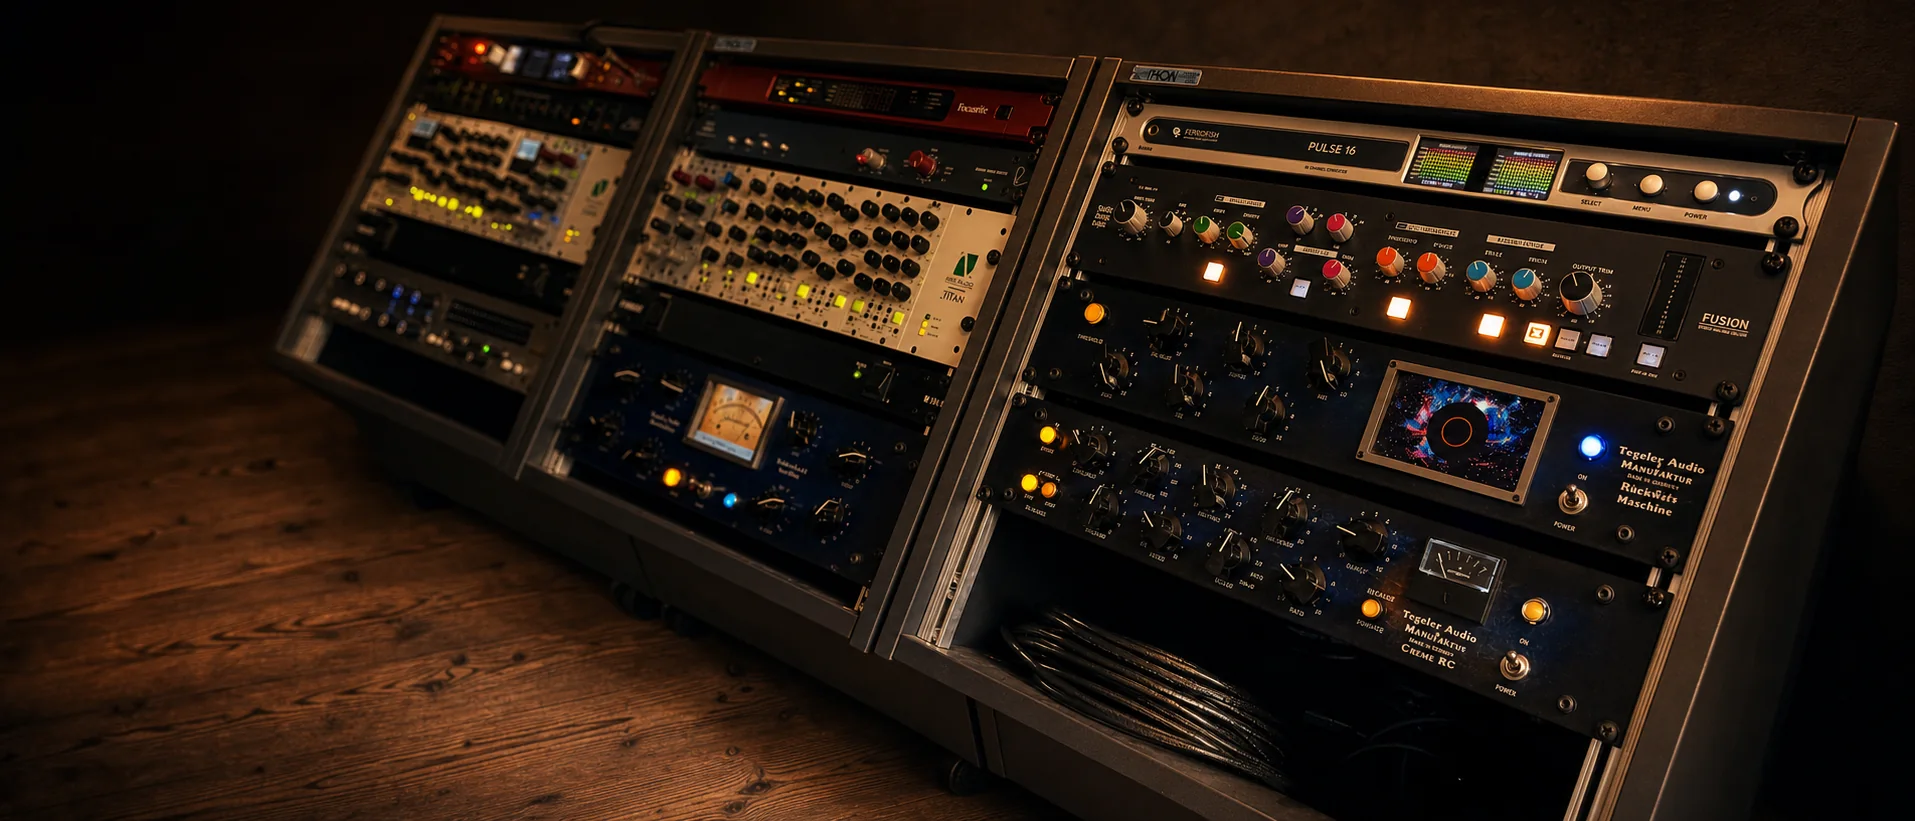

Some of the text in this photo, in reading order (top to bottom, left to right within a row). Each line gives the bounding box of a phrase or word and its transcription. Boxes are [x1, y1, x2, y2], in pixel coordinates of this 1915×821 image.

[1307, 141, 1357, 156] PULSE 16
[1581, 199, 1602, 207] SELECT
[1632, 205, 1652, 213] MENU
[1684, 212, 1708, 221] POWER
[1572, 263, 1597, 273] OUTPUT
[1701, 312, 1750, 331] FUSION
[1619, 445, 1705, 475] Tegeler Audio
[1577, 473, 1588, 481] ON
[1620, 459, 1693, 486] MANUFAKTUR
[1616, 494, 1673, 517] Maschine
[1553, 520, 1576, 532] POWER
[1403, 609, 1443, 630] Tegeler
[1444, 625, 1478, 644] Audio
[1438, 656, 1457, 669] RC
[1494, 683, 1517, 697] POWER
